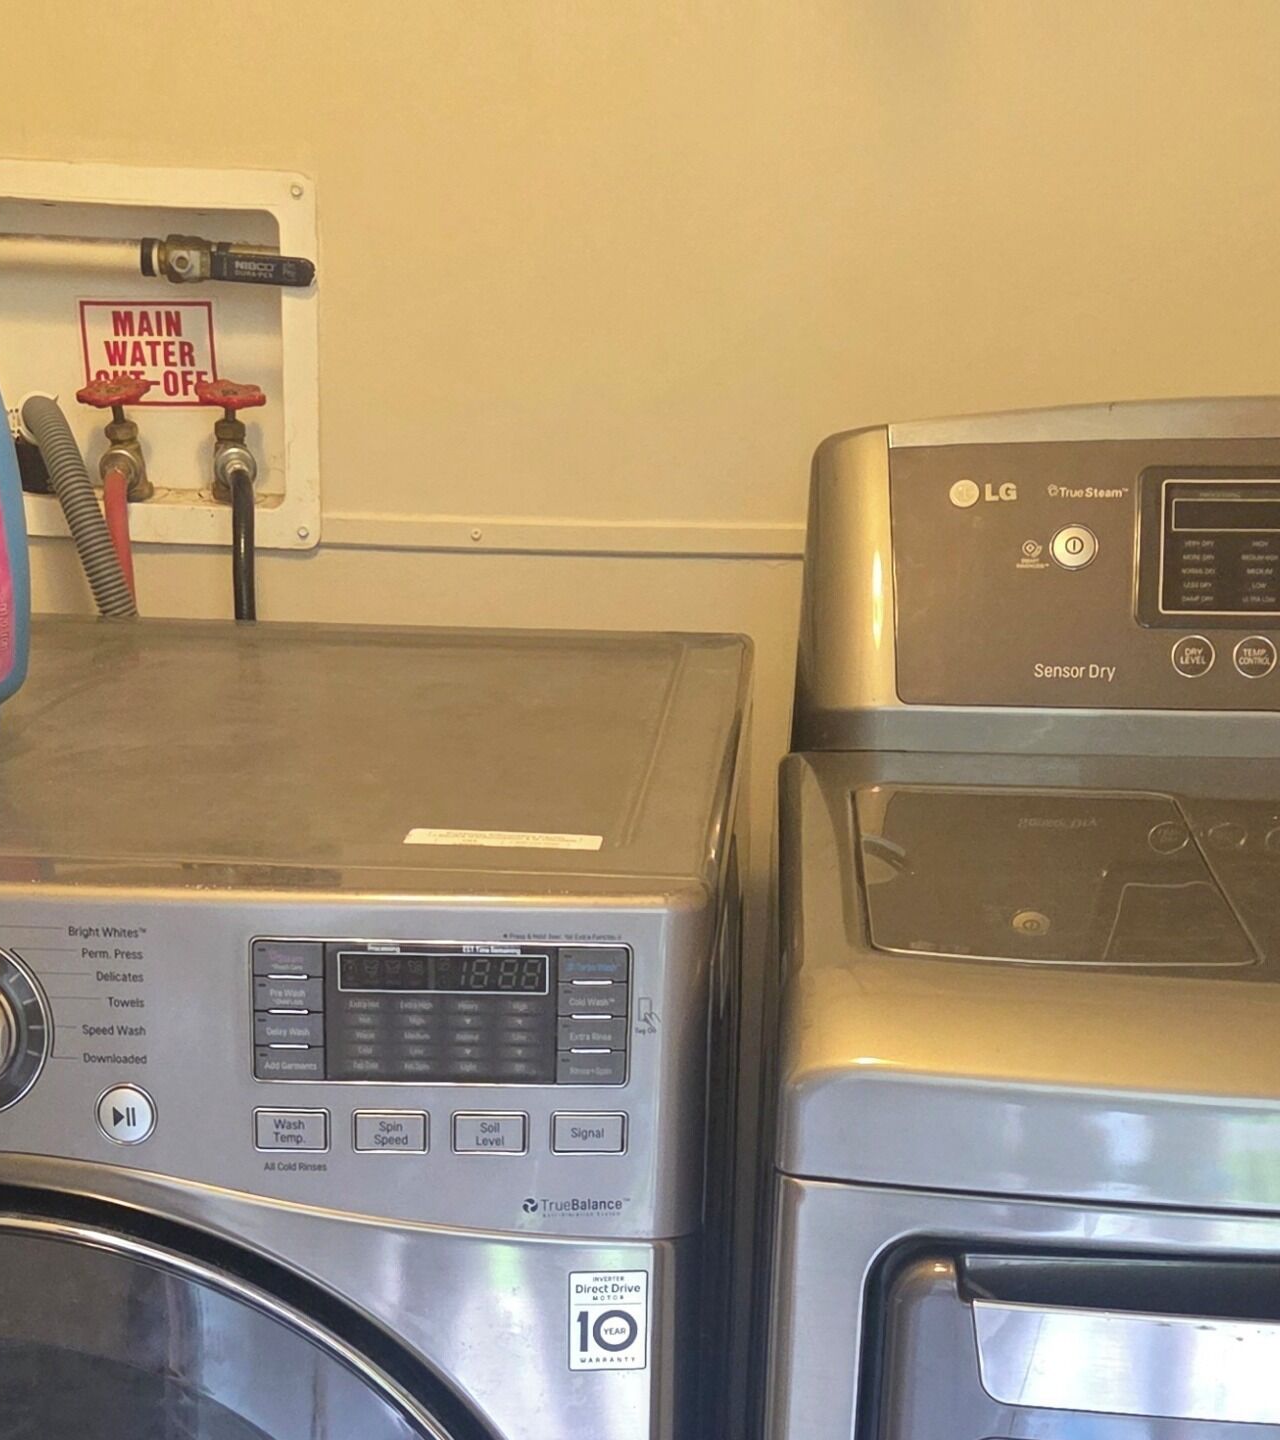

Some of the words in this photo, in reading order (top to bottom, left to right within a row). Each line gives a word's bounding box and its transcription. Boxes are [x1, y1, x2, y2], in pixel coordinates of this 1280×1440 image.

[112, 311, 182, 337] MAIN
[104, 341, 195, 367] WATER
[985, 483, 1017, 501] LG
[1184, 648, 1203, 656] DRY
[1180, 655, 1206, 665] LEVEL
[1238, 657, 1270, 666] CONTROL
[1034, 663, 1086, 678] Sensor
[1089, 664, 1116, 682] Dry
[68, 926, 99, 939] Bright
[82, 948, 111, 959] Perm.
[114, 949, 143, 960] Press
[96, 971, 144, 982] Delicates
[107, 997, 145, 1008] Towels
[82, 1025, 114, 1037] Speed
[117, 1025, 146, 1036] Wash
[83, 1053, 147, 1064] Downloaded
[264, 1061, 280, 1070] Add
[273, 1119, 305, 1130] Wash
[379, 1121, 403, 1133] Spin
[480, 1122, 500, 1133] Soil
[274, 1132, 306, 1144] Temp.
[571, 1127, 605, 1140] Signal
[374, 1134, 408, 1146] Speed
[476, 1136, 505, 1146] Level
[264, 1162, 276, 1171] All
[277, 1162, 297, 1171] Cold
[298, 1162, 328, 1172] Rinses
[575, 1284, 609, 1294] Direct
[611, 1284, 641, 1293] Drive
[577, 1310, 638, 1352] 10
